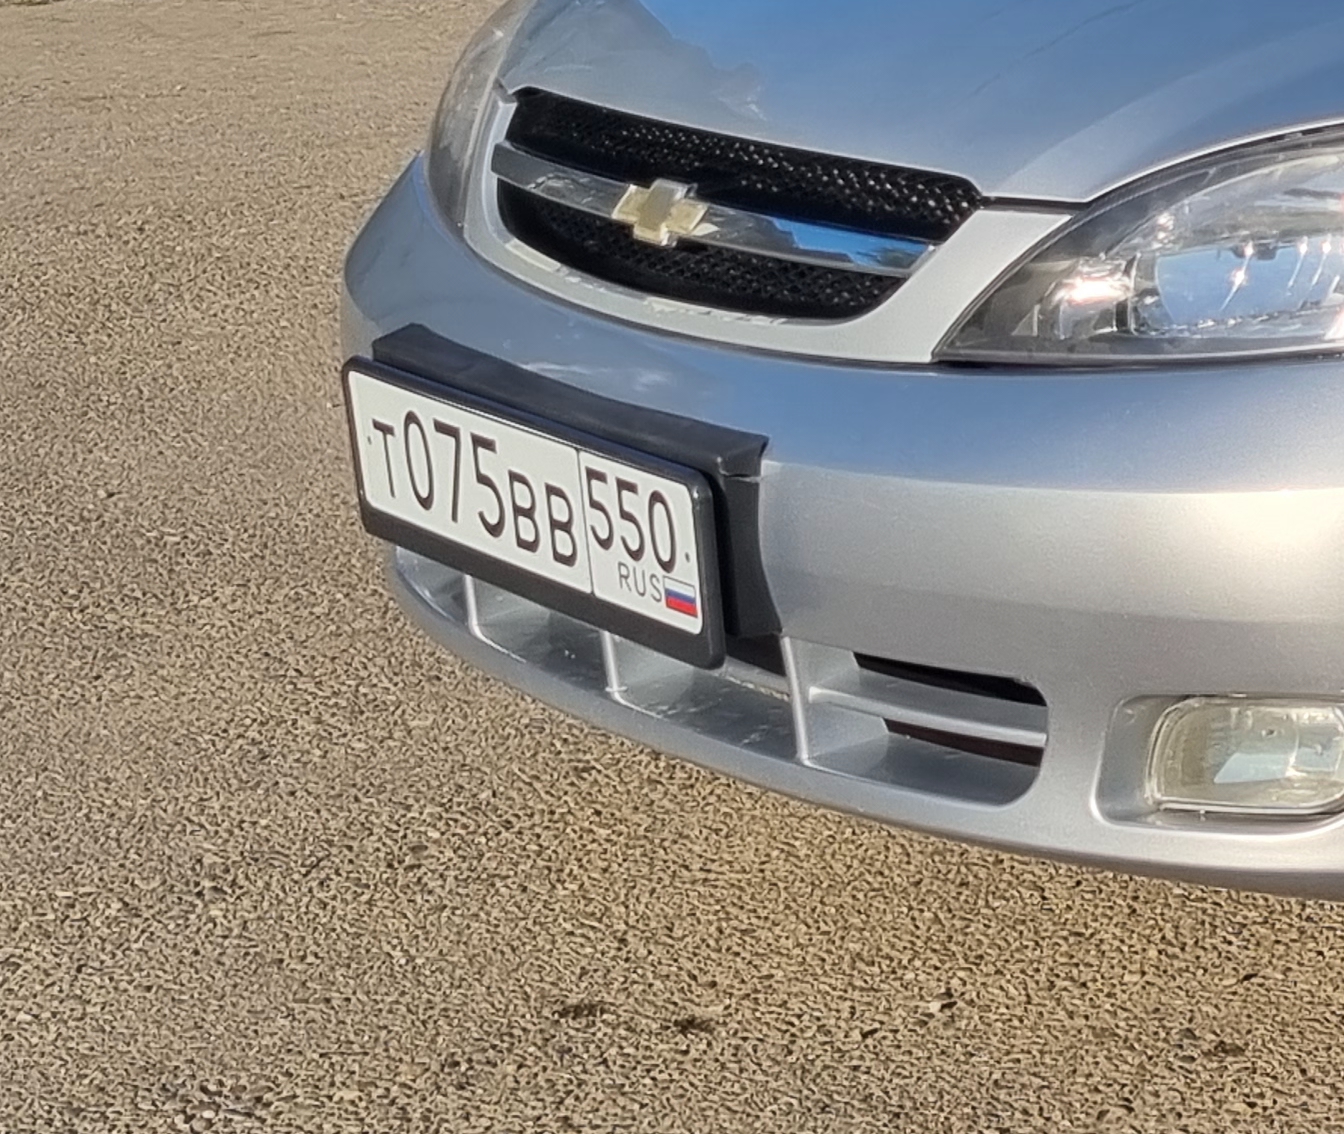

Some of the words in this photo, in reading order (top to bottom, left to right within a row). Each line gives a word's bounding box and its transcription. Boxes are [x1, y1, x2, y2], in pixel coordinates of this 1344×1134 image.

[371, 409, 579, 568] Т075ВВ
[584, 465, 678, 574] 550
[616, 561, 663, 604] RUS
